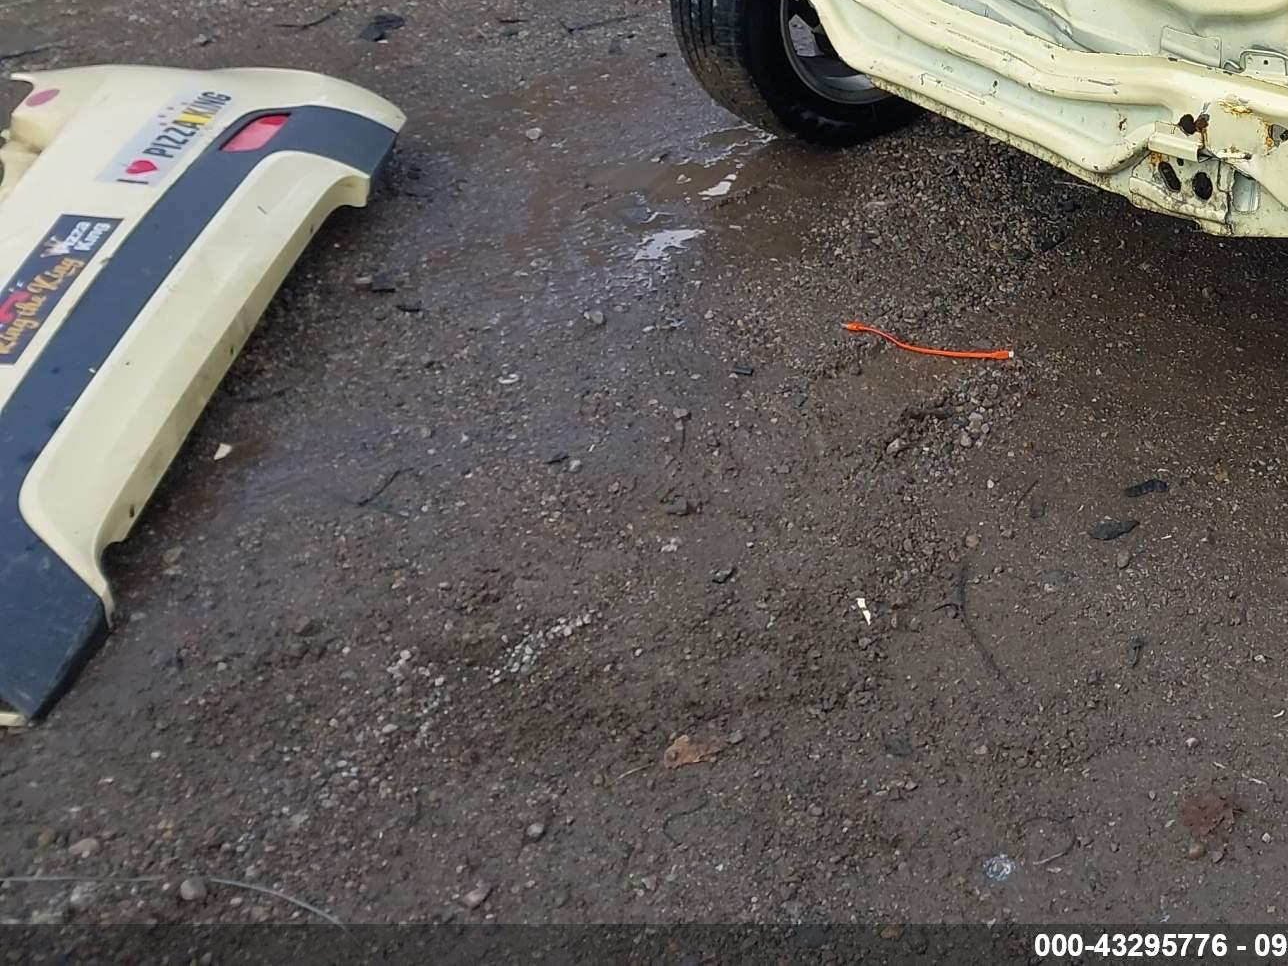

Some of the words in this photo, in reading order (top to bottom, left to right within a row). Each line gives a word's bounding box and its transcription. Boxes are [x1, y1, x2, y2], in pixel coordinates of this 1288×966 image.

[142, 120, 205, 159] PIZZA
[181, 91, 232, 119] KING
[73, 222, 112, 251] King
